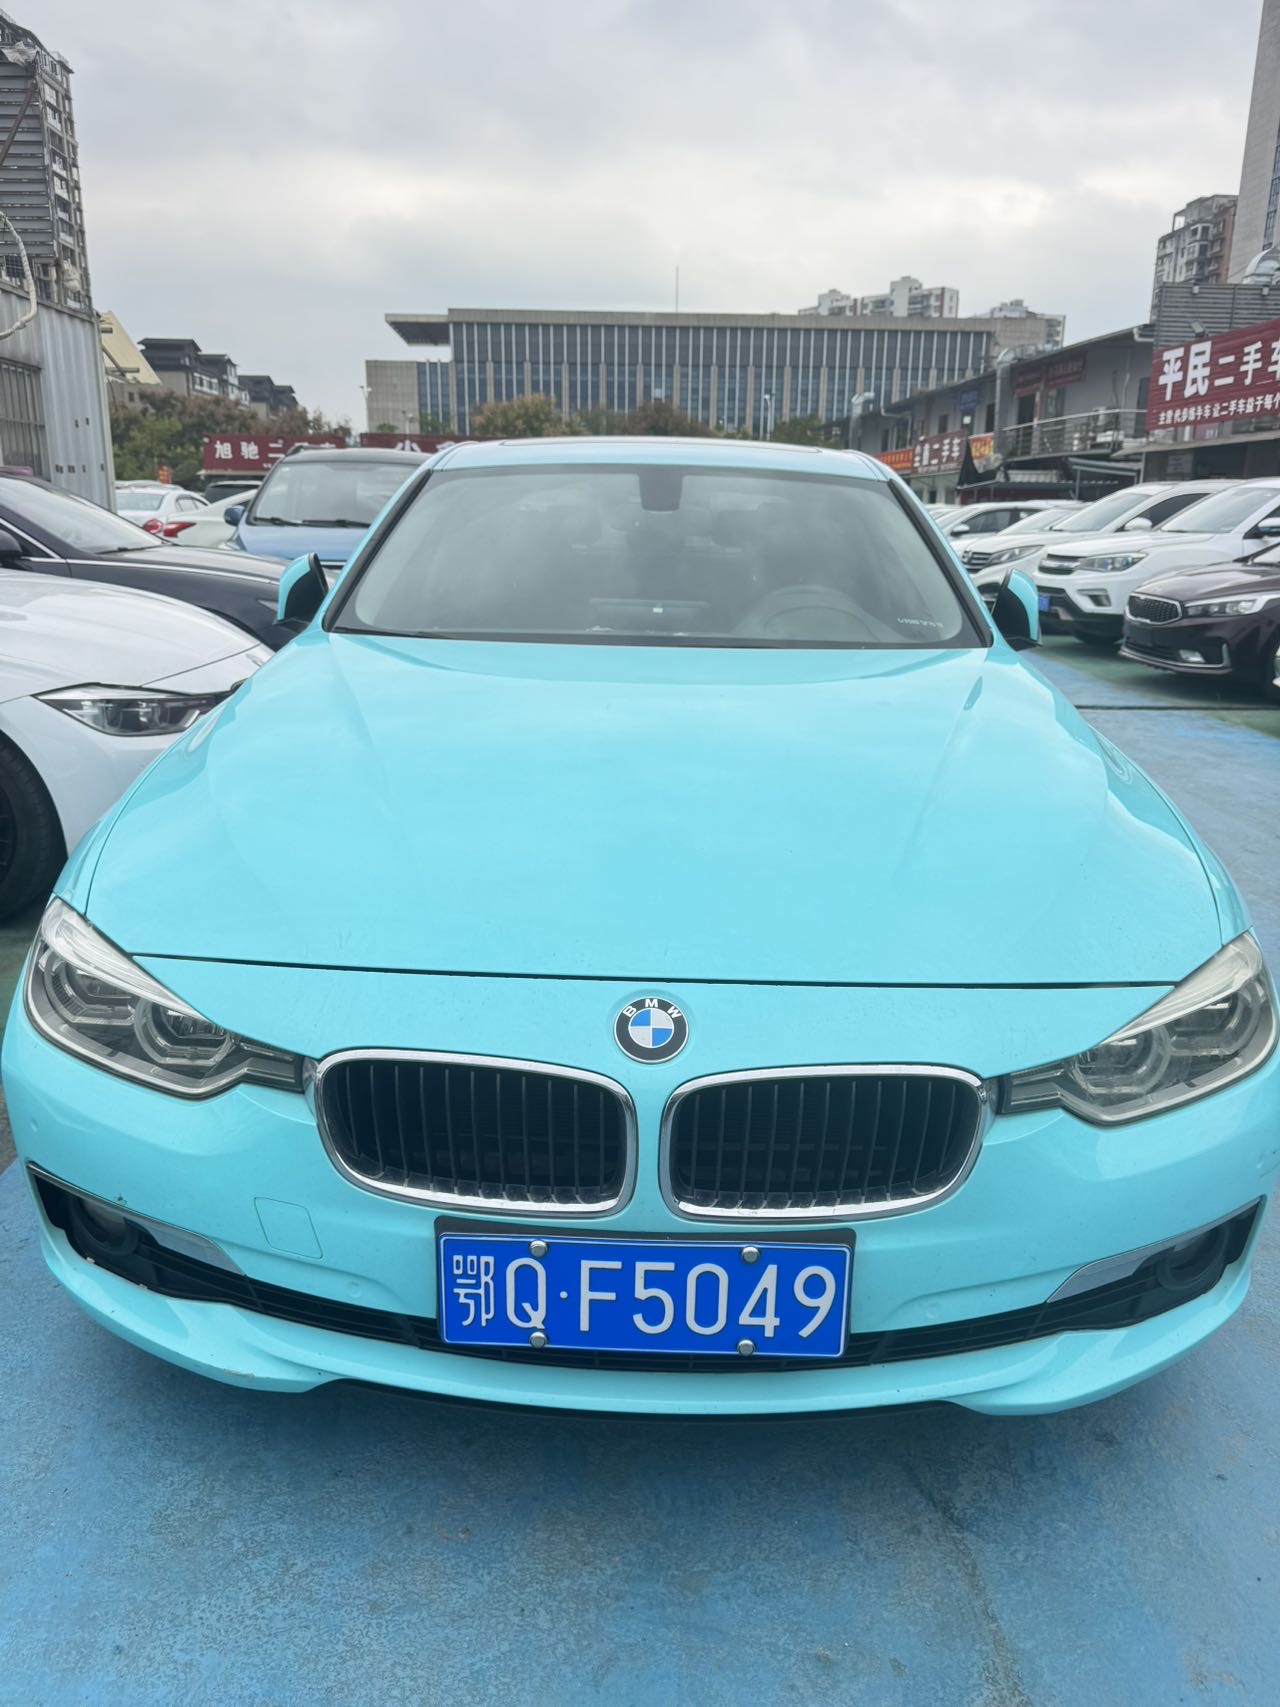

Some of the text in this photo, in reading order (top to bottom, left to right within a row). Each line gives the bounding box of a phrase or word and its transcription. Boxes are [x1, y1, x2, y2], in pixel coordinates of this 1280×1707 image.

[214, 440, 336, 459] 旭驰二
[622, 998, 682, 1018] BMW
